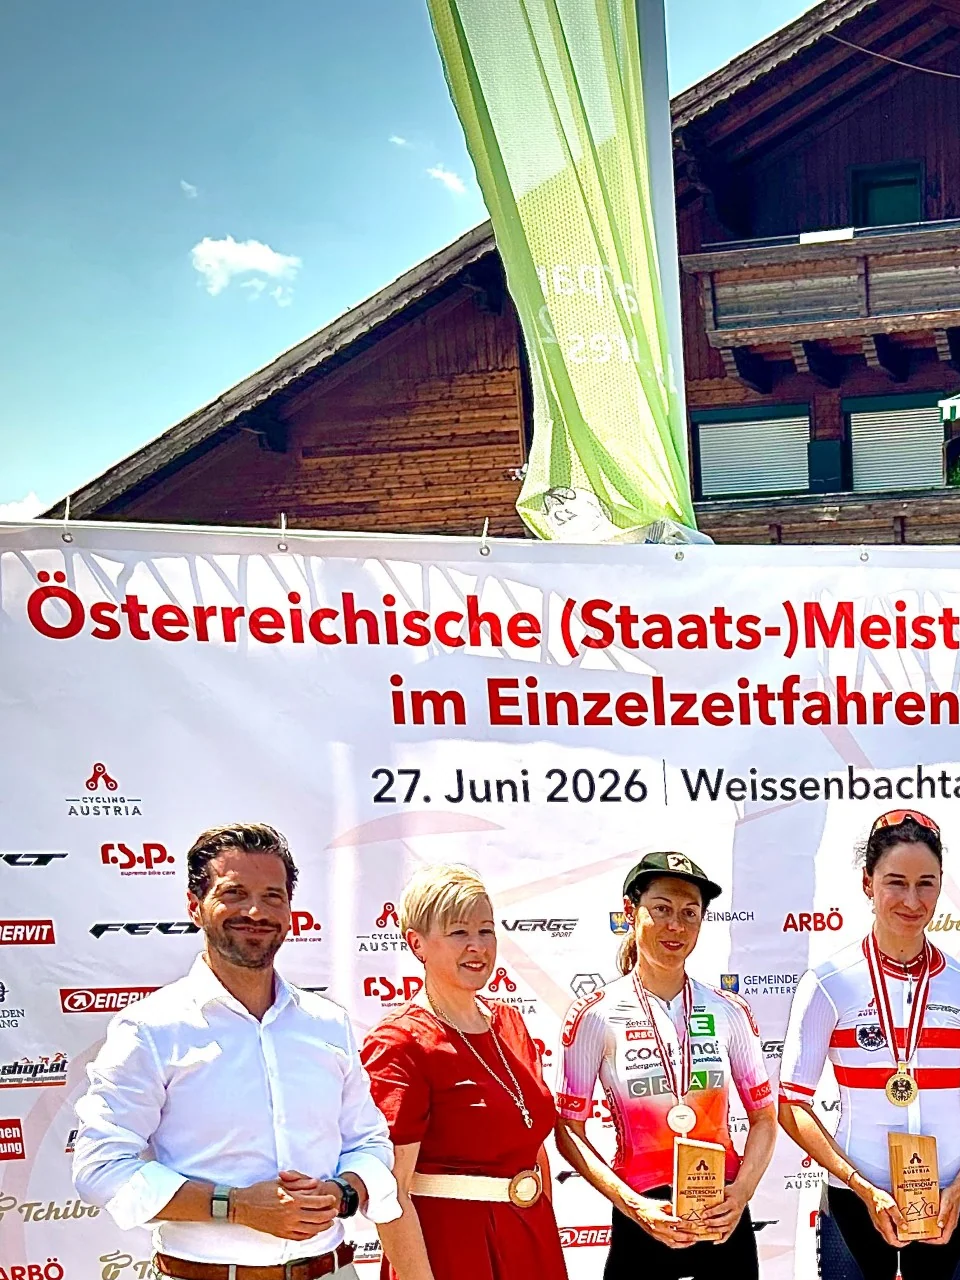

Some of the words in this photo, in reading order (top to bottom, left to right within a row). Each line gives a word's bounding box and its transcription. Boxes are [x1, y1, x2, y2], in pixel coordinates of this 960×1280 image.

[26, 571, 542, 647] Österreichische
[391, 674, 466, 726] im
[488, 674, 960, 727] Einzelzeitfahren
[371, 769, 431, 803] 27.
[444, 768, 531, 804] Juni
[547, 769, 648, 803] 2026
[68, 806, 142, 816] AUSTRIA
[501, 918, 579, 932] VERGE
[783, 907, 843, 932] ARBÖ
[743, 974, 798, 985] GEMEINDE
[744, 987, 758, 995] AM
